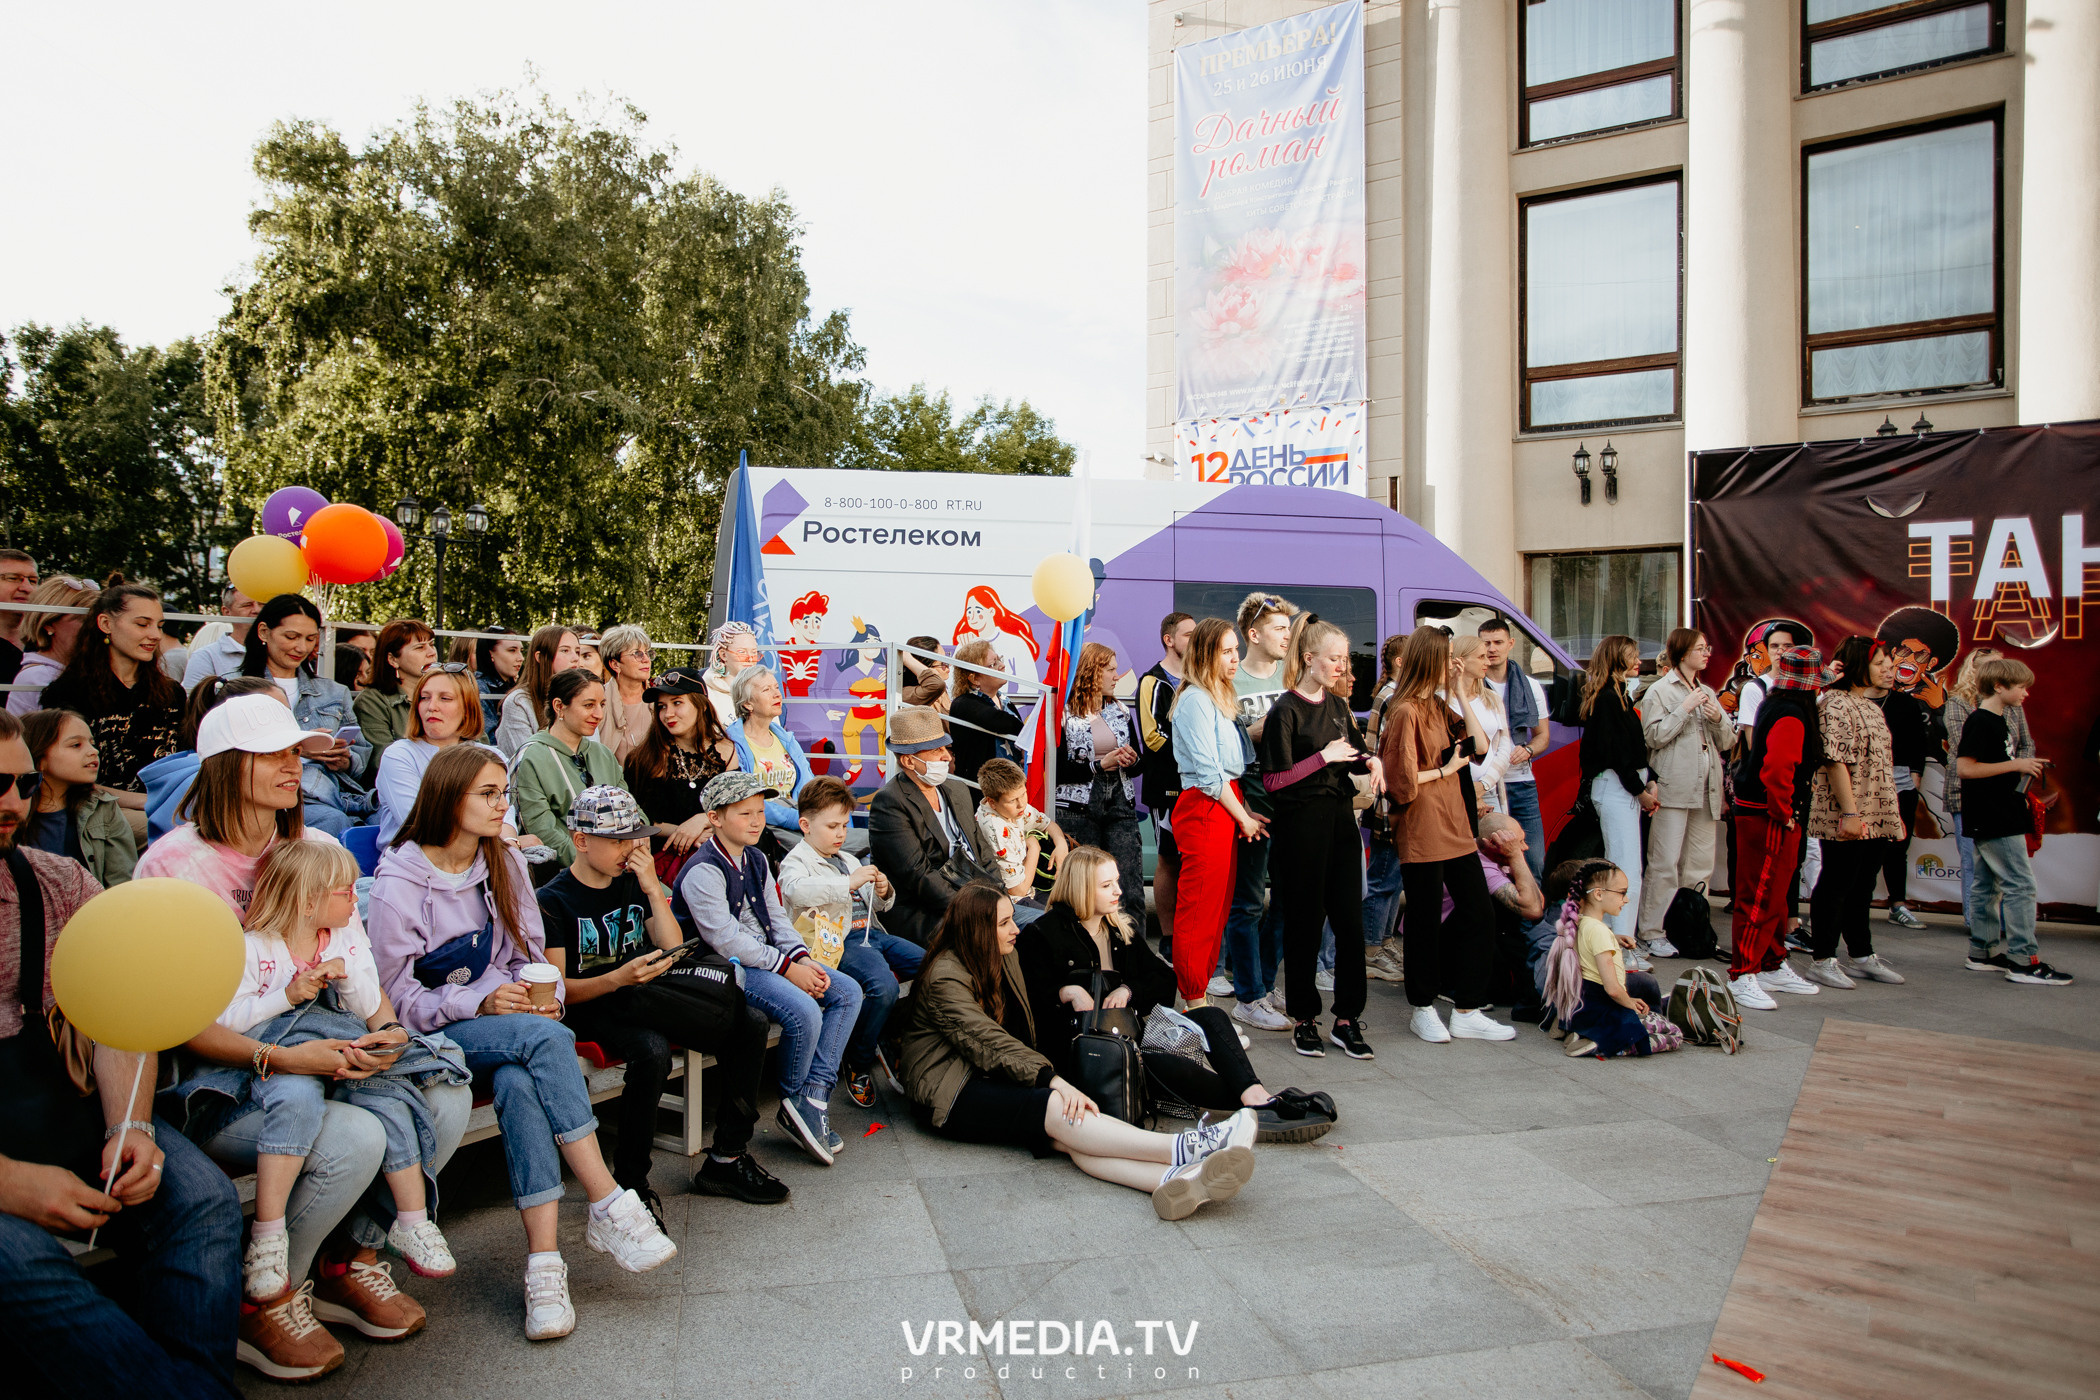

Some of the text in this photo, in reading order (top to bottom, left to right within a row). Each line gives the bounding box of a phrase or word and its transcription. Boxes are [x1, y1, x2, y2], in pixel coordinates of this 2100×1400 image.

[1199, 22, 1337, 77] ПРЕМЬЕРА!
[1213, 79, 1232, 97] 25
[1249, 71, 1270, 88] 26
[1273, 55, 1328, 82] ИЮНЯ
[1193, 86, 1343, 154] Дачный
[1200, 135, 1328, 198] роман
[1249, 176, 1293, 193] КОМЕДИЯ
[1191, 443, 1307, 483] 12 ДЕНЬ
[1229, 460, 1349, 487] РОССИИ
[824, 496, 983, 512] 8-800-100-0-800 RT.RU
[803, 520, 982, 548] Ростелеком
[694, 966, 729, 984] RONNY
